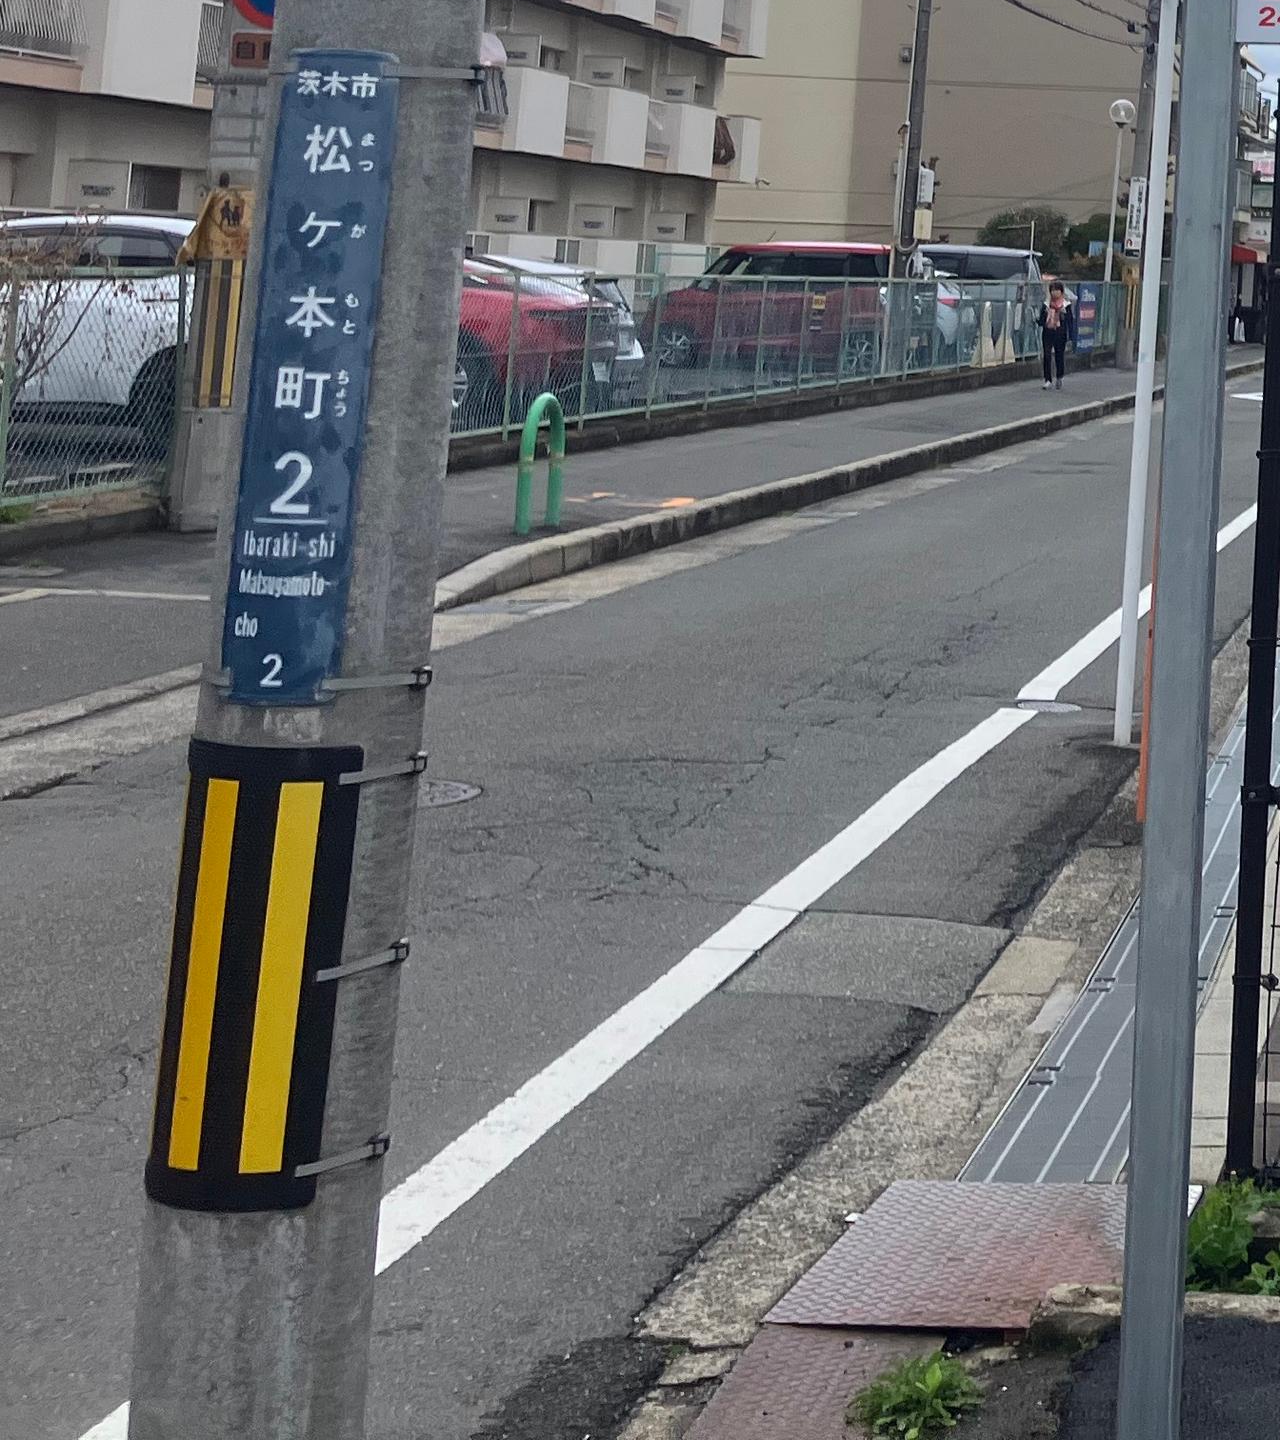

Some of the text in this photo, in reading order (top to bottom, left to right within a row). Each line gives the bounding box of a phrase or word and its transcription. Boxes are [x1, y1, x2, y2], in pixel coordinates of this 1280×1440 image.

[297, 71, 379, 98] 茨木市
[270, 450, 313, 515] 2
[234, 611, 258, 637] cho
[259, 654, 283, 688] 2
